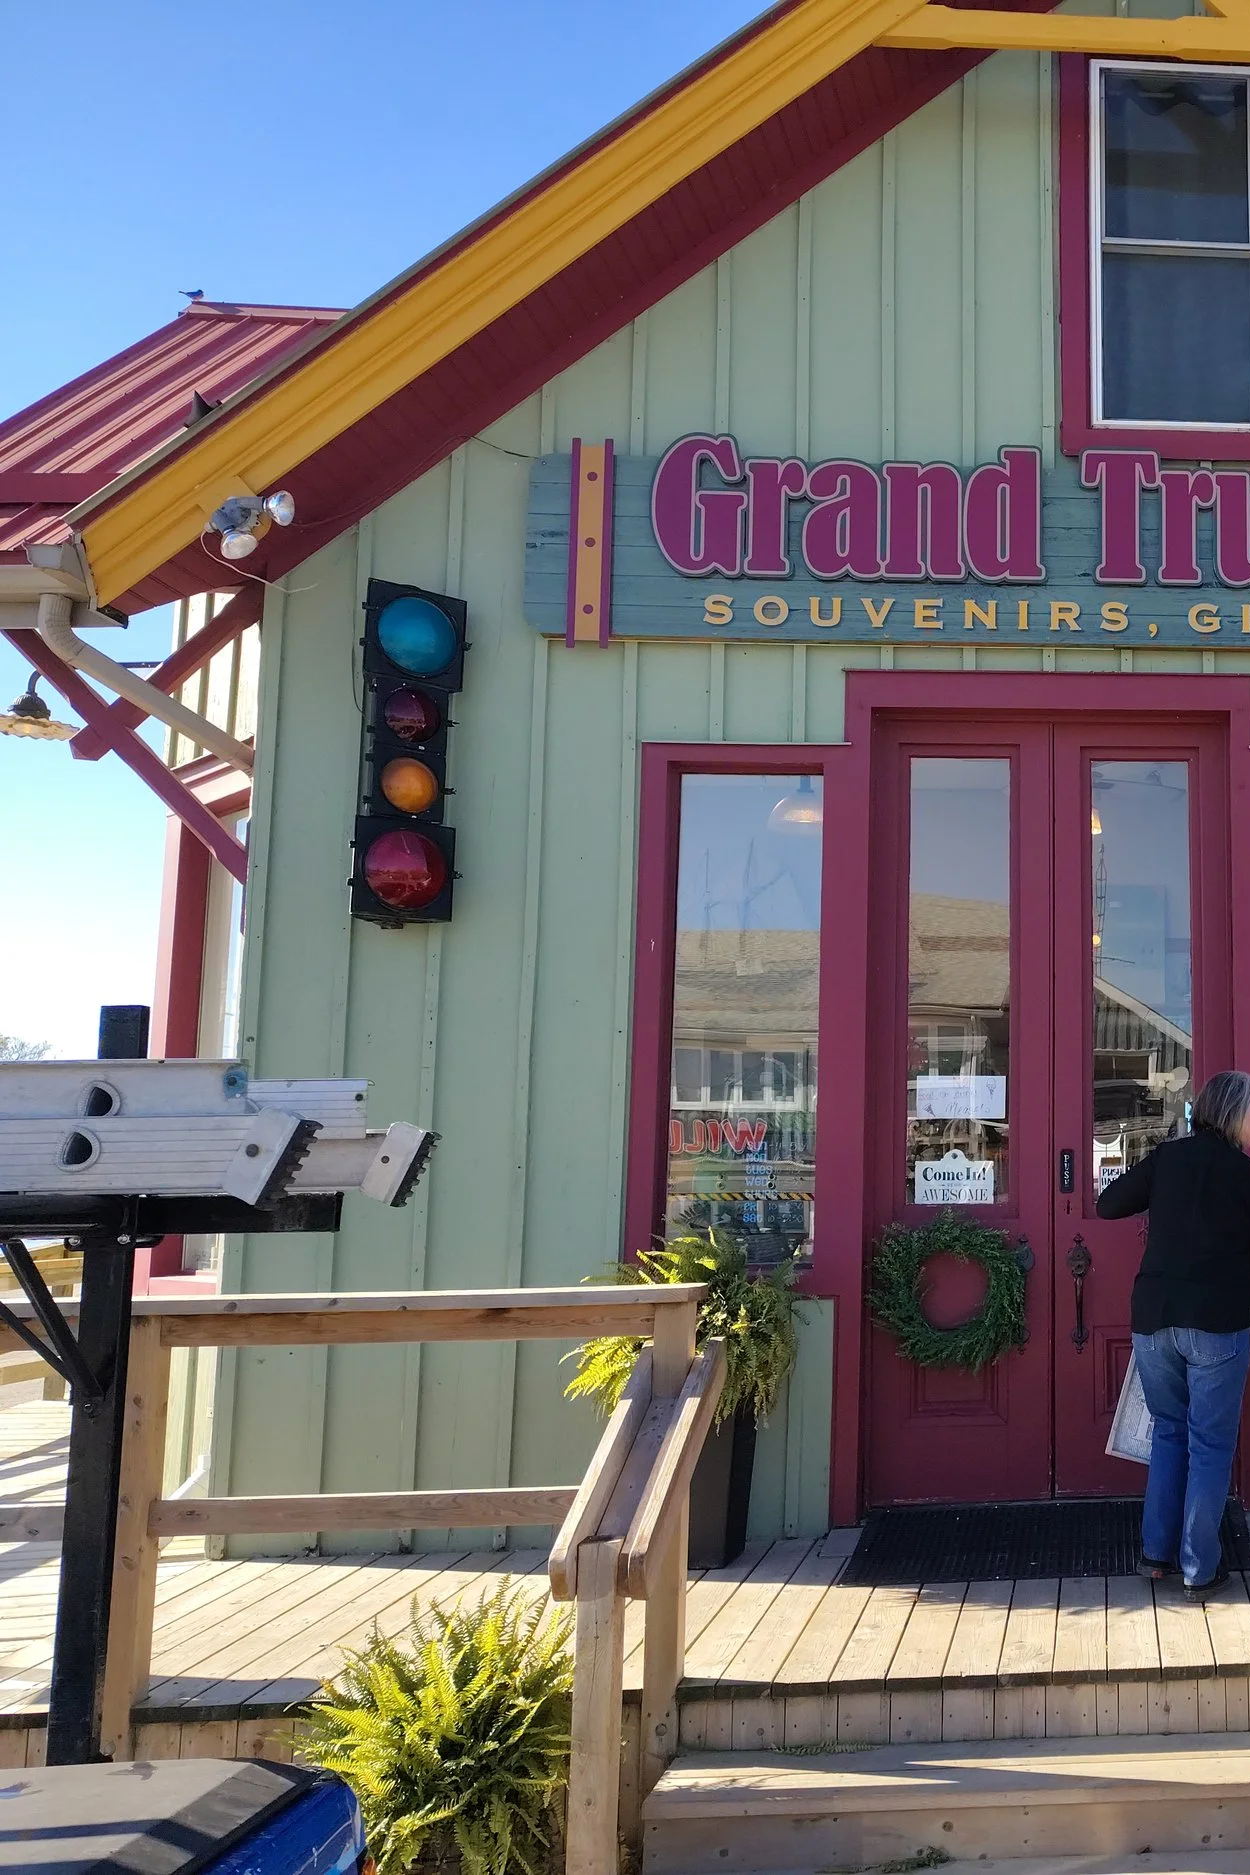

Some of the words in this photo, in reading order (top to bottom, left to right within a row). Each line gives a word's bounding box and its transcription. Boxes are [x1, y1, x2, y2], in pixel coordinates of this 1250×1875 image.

[651, 432, 1048, 583] Grand
[703, 594, 1158, 639] SOUVENIRS,
[922, 1166, 964, 1182] Come
[922, 1188, 989, 1202] AWESOME
